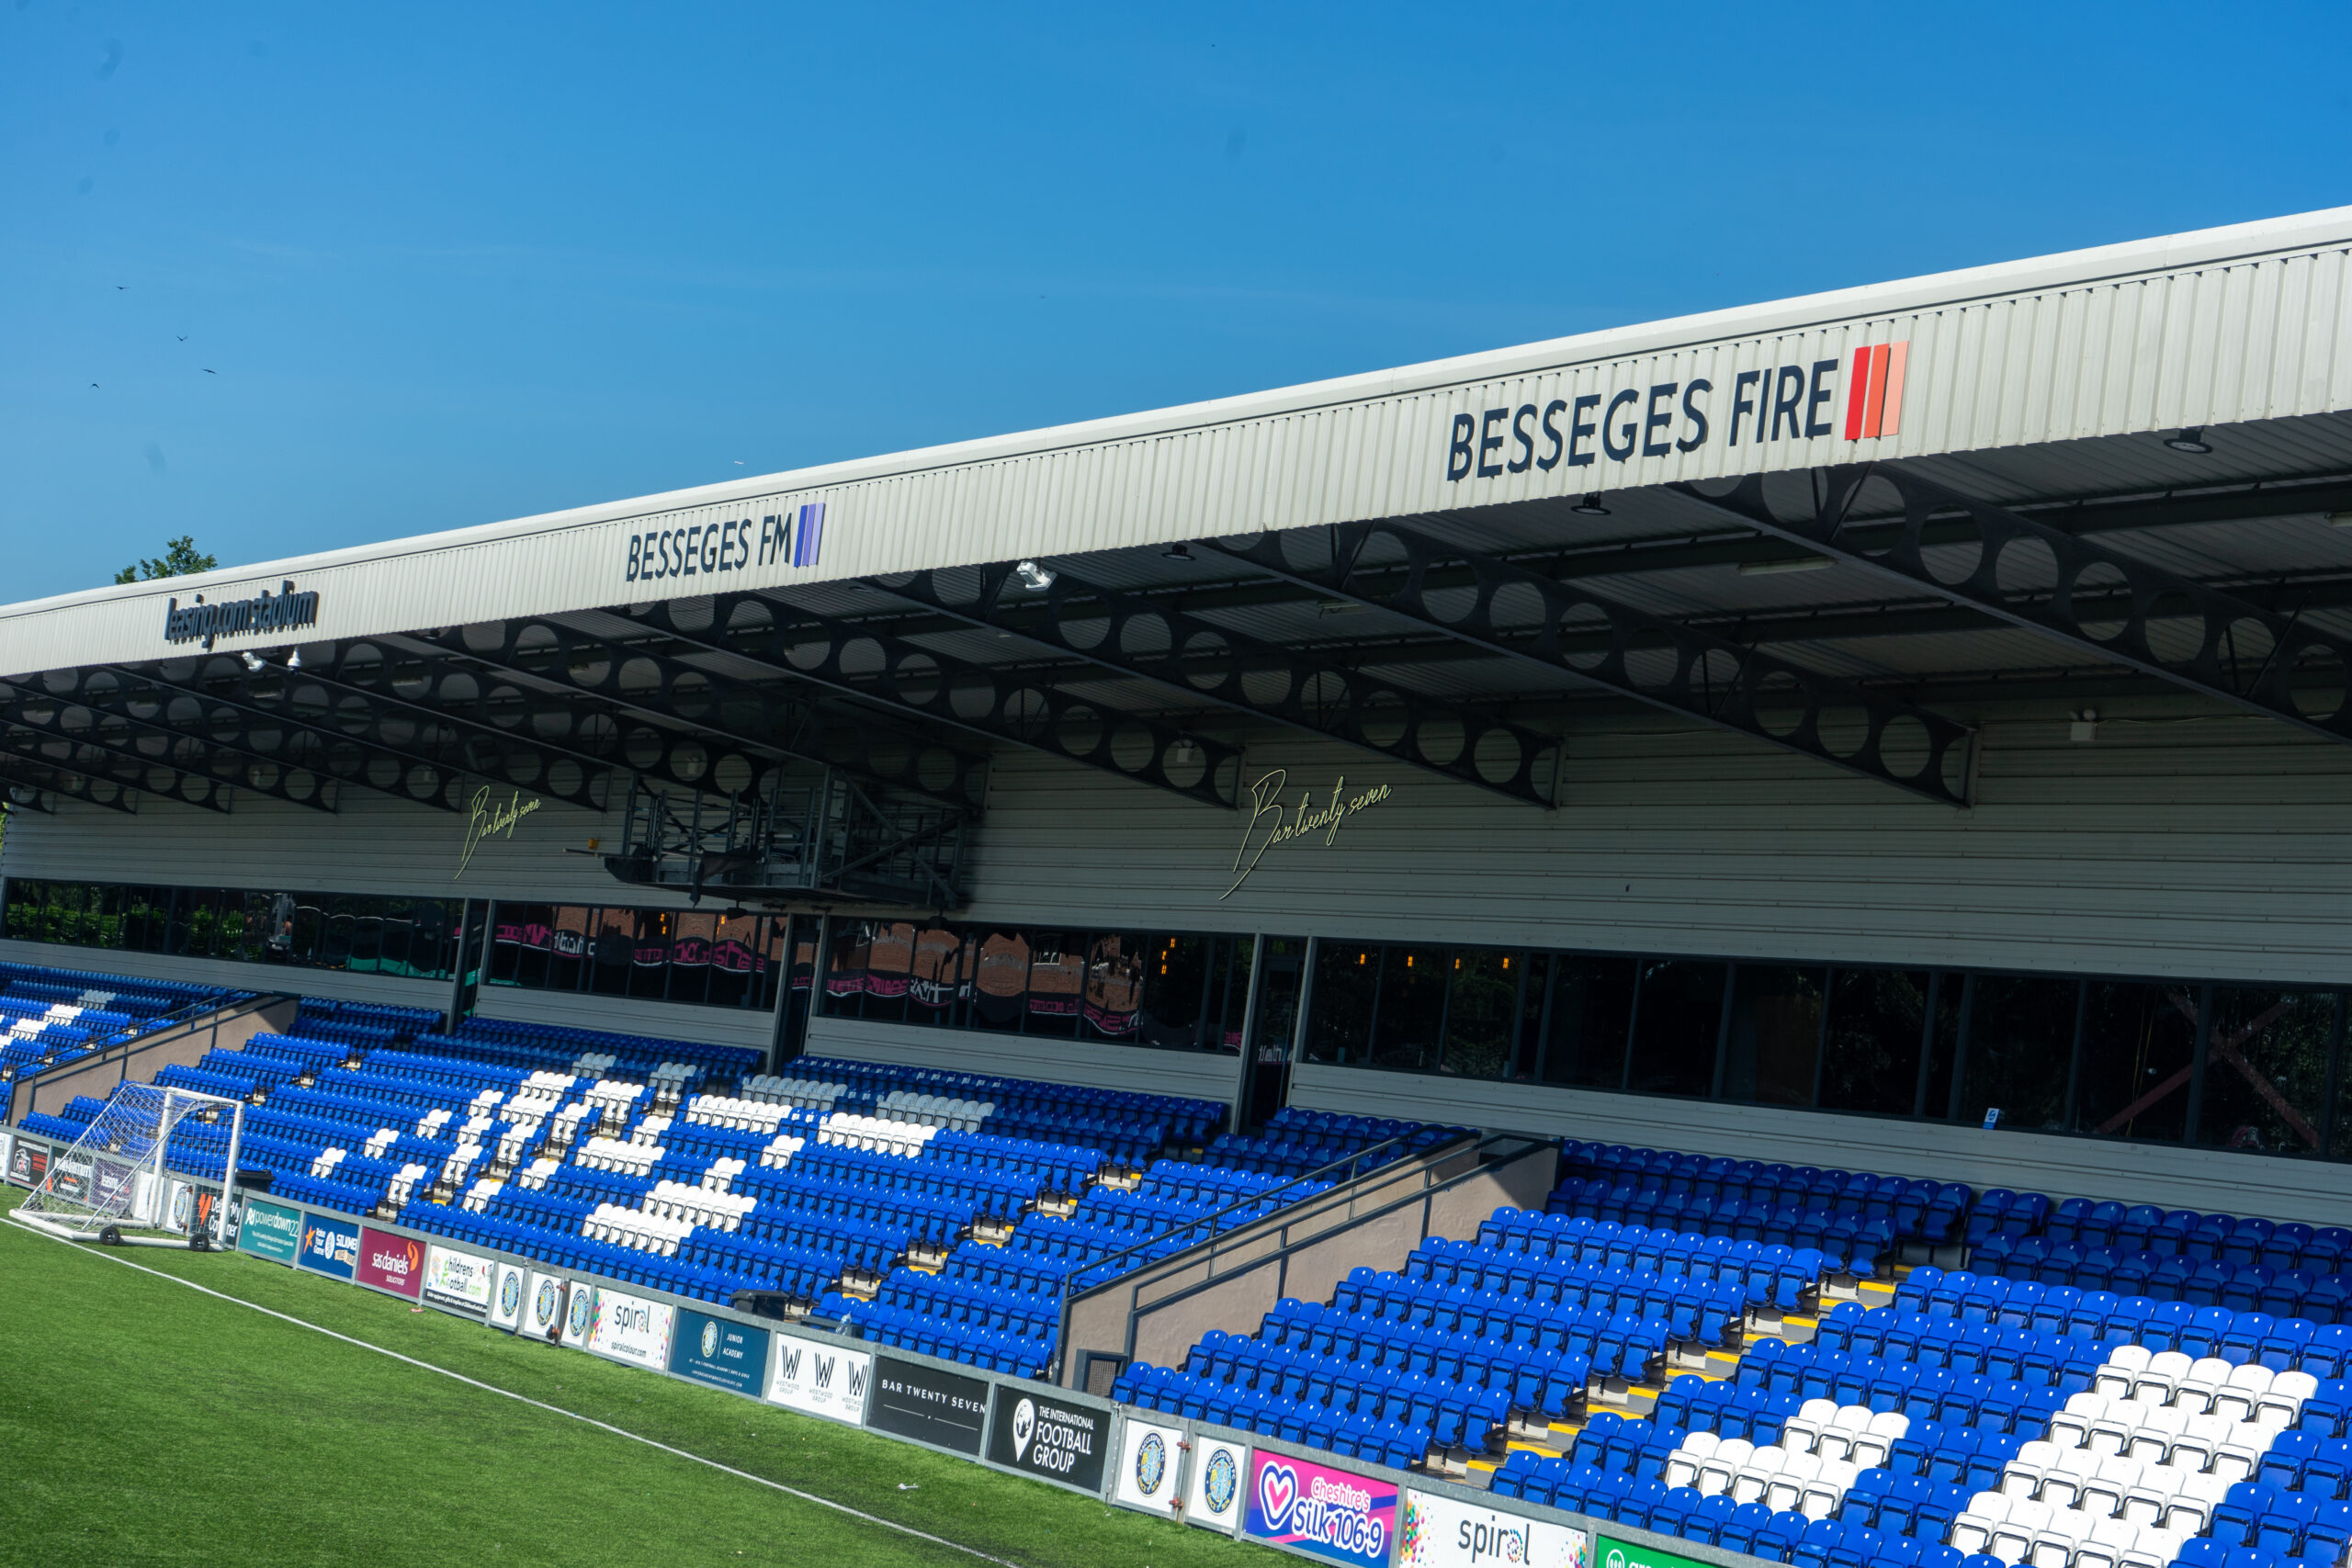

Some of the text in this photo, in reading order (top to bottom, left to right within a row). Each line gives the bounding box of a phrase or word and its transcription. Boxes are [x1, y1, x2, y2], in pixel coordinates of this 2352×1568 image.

[1446, 358, 1839, 482] BESSEGES FIRE
[626, 512, 793, 581] BESSEGES FM
[250, 580, 319, 633] stadium
[1218, 769, 1394, 901] Bar twenty seven
[371, 1252, 382, 1269] sas
[381, 1249, 409, 1276] daniels
[614, 1300, 650, 1334] spiral
[610, 1341, 648, 1359] spiralcolour.com
[722, 1346, 743, 1359] ACADEMY
[726, 1333, 743, 1344] JUNIOR
[882, 1379, 987, 1416] BAR TWENTY SEVEN
[1039, 1405, 1094, 1431] THE INTERNATIONAL
[1036, 1420, 1092, 1455] FOOTBALL
[1033, 1444, 1076, 1473] GROUP
[1311, 1477, 1371, 1513] Cheshire's
[1458, 1515, 1530, 1565] spiral
